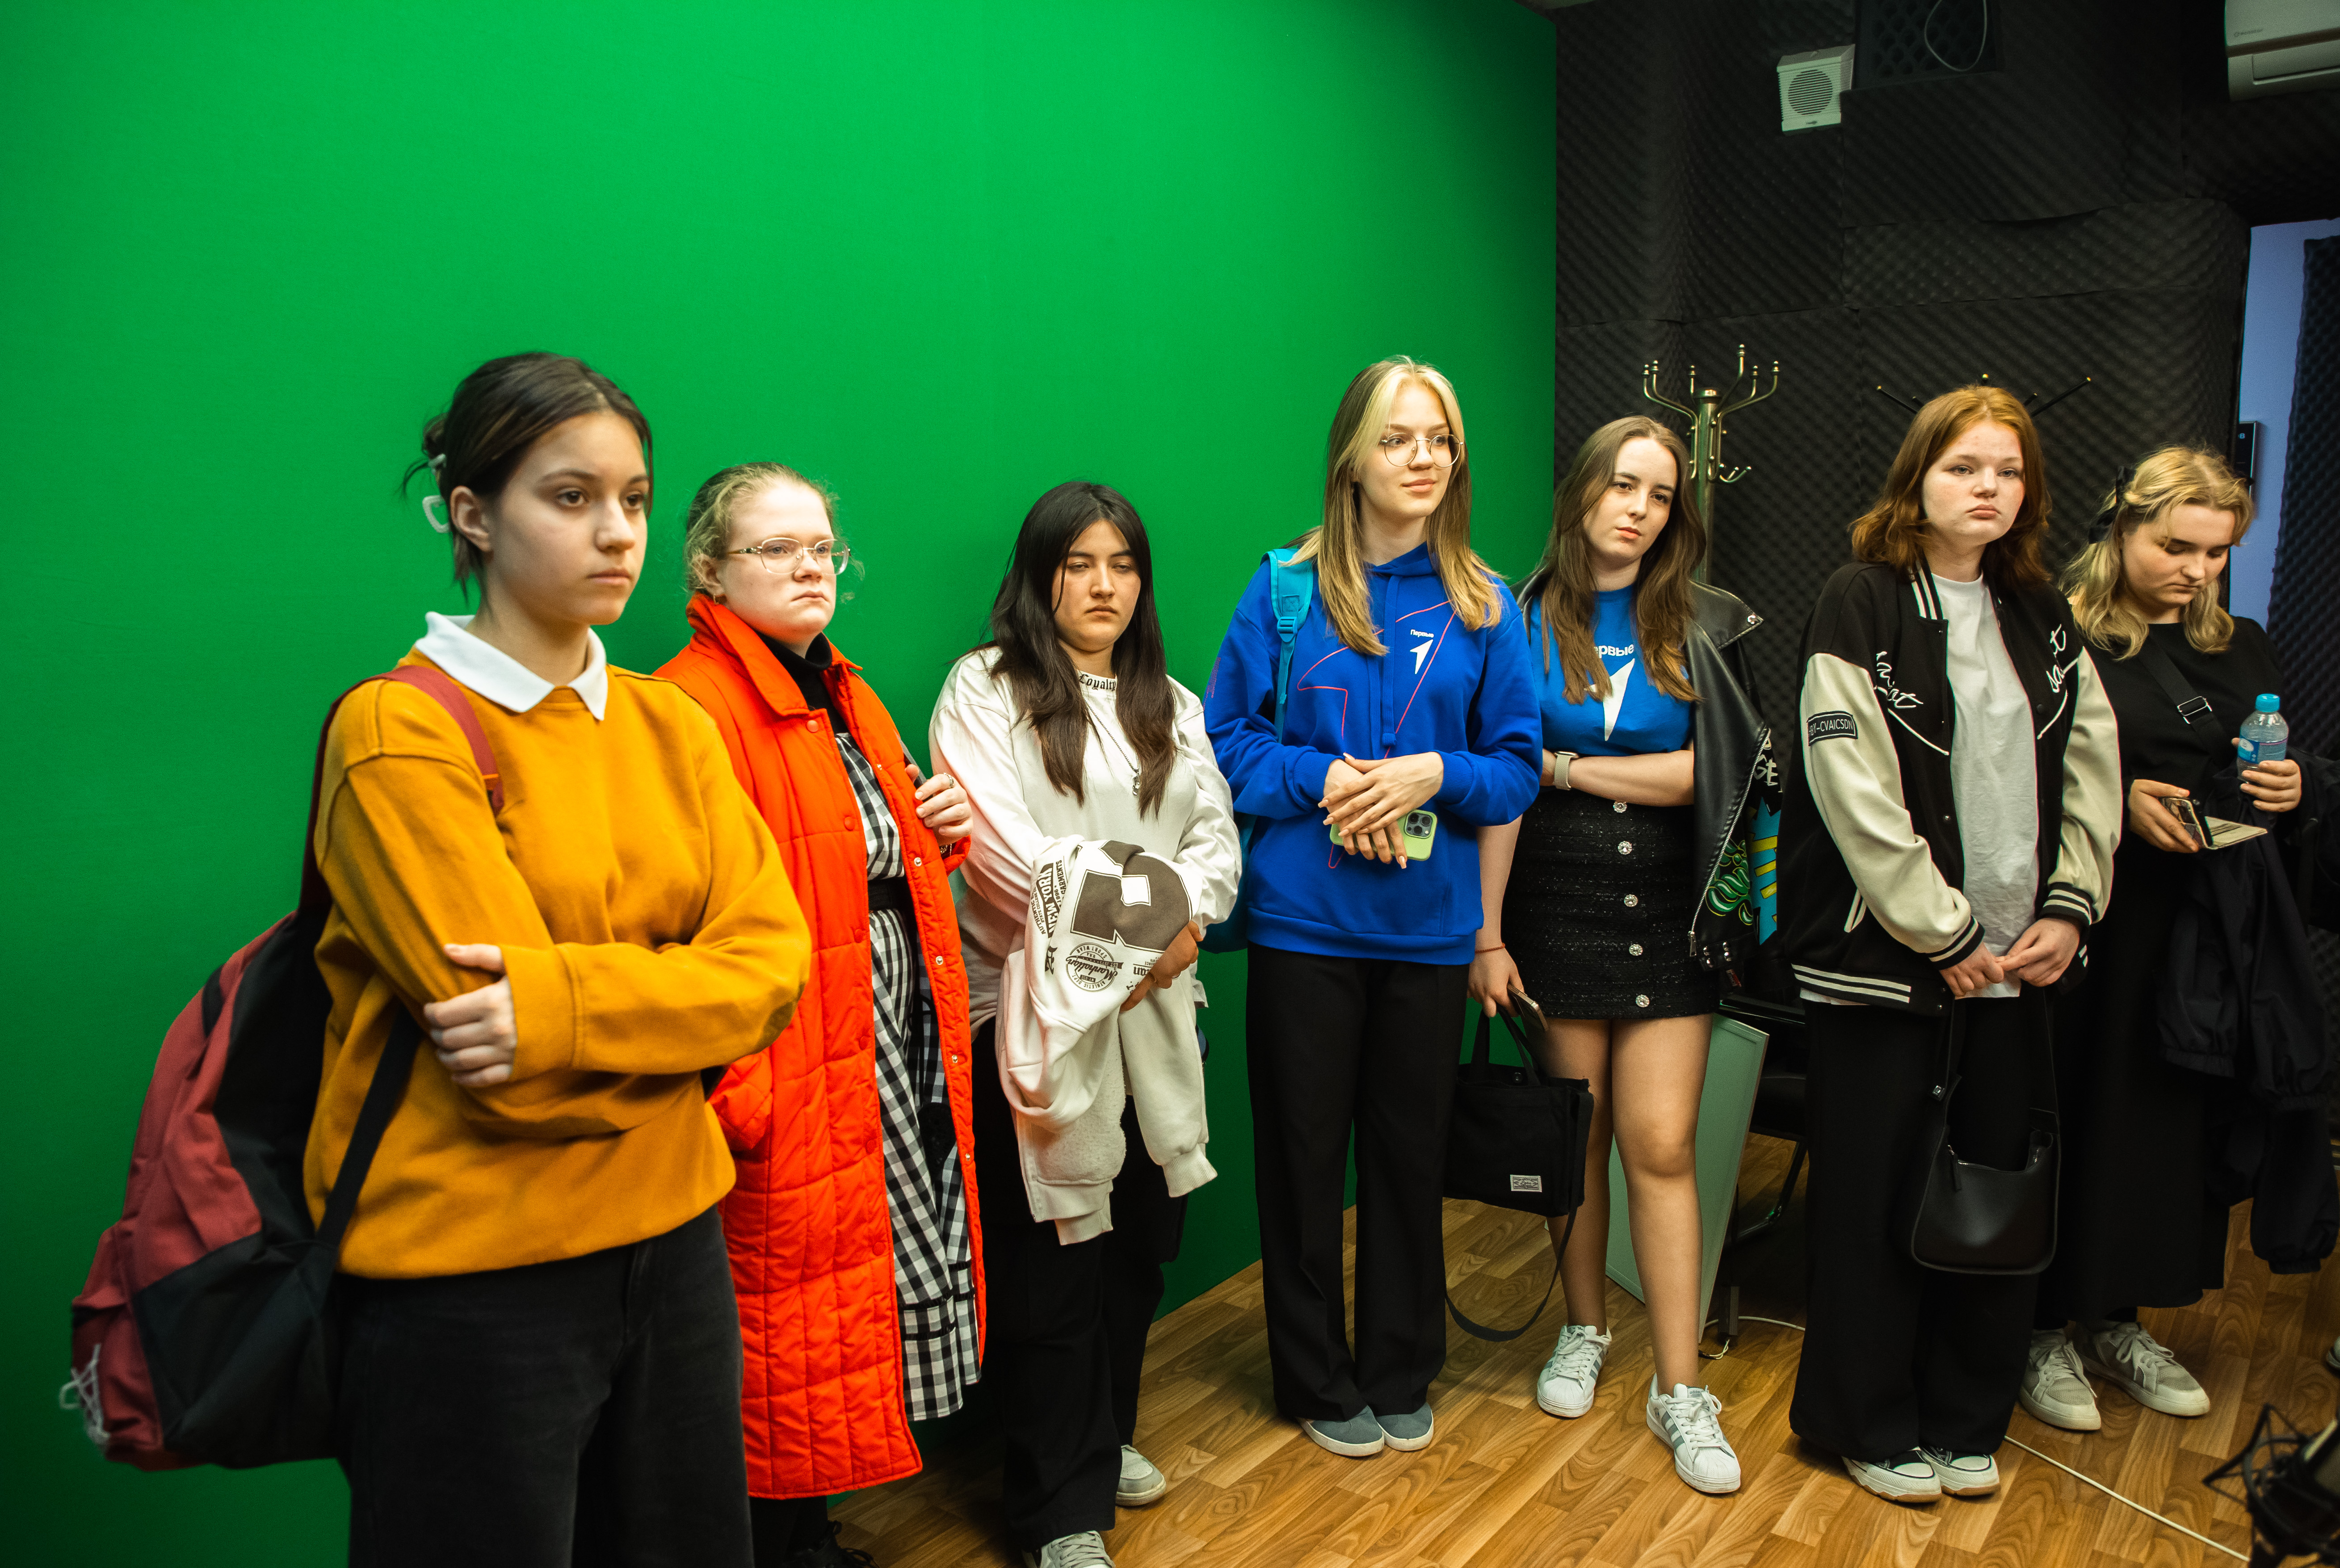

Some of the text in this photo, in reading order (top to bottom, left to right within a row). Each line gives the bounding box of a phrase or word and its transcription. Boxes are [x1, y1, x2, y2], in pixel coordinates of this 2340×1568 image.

[1411, 629, 1434, 638] Первые
[1079, 674, 1116, 692] Loyalty
[1038, 867, 1052, 902] YORK
[1056, 860, 1067, 894] GARMENTS
[1031, 900, 1046, 934] AUTHENTIC
[1046, 902, 1059, 933] NEW
[1092, 946, 1107, 958] SPORT
[1066, 957, 1118, 981] Manhattan
[1084, 980, 1105, 989] ATHLETIC
